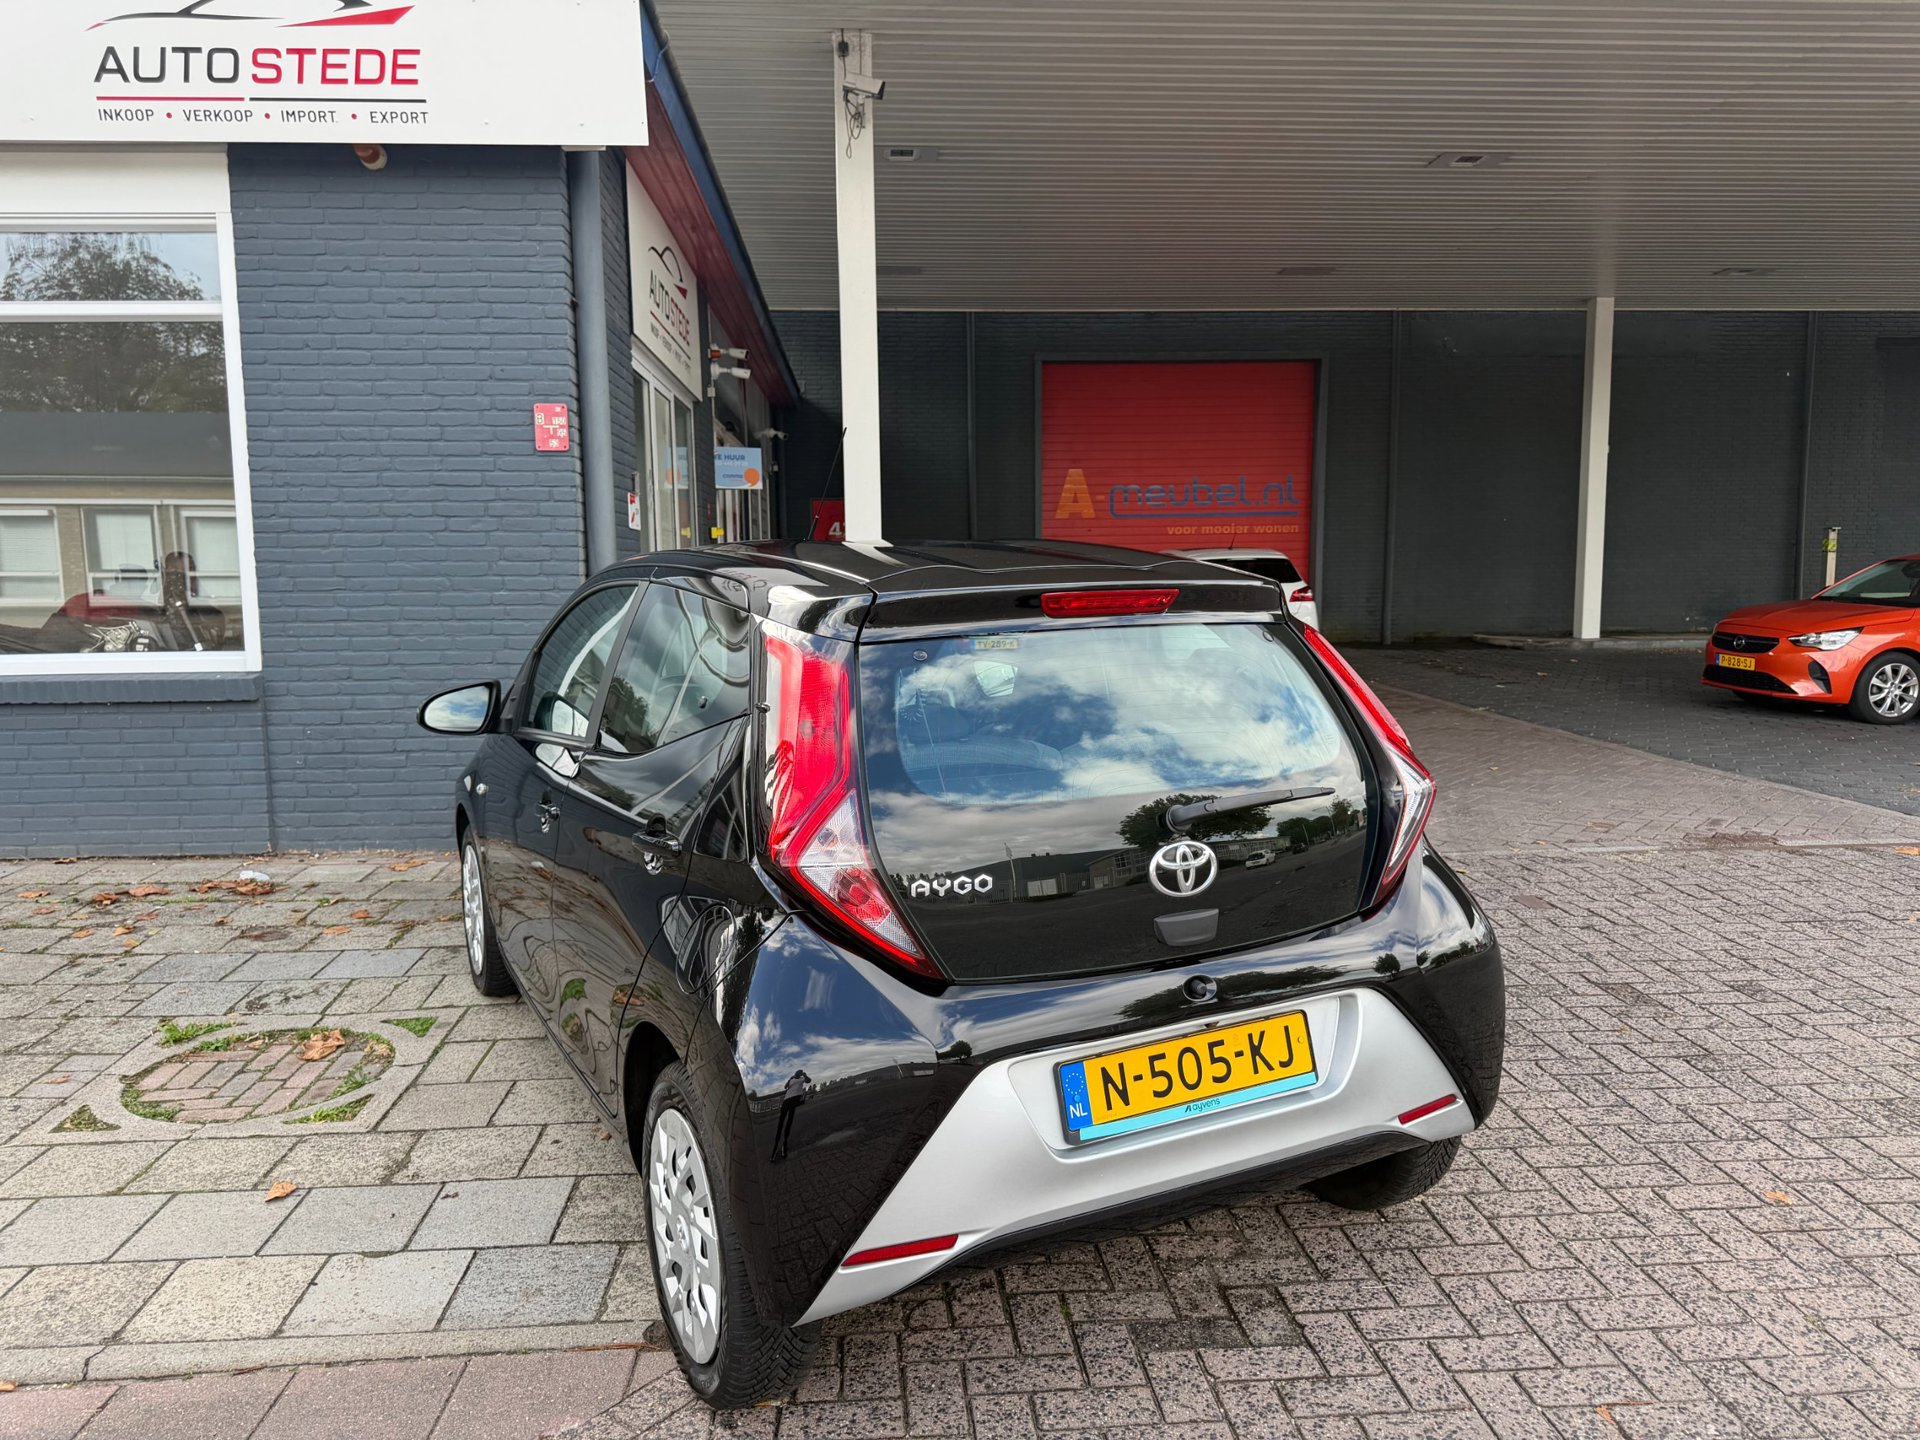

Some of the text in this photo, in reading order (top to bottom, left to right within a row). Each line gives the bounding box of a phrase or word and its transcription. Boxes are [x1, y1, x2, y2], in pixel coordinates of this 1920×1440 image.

[98, 108, 429, 124] INKOOP VERKOOP IMPORT EXPORT
[1167, 523, 1299, 535] voor mooier wonen
[1721, 656, 1752, 669] P-828-SJ
[910, 873, 993, 898] AYGO
[1100, 1025, 1294, 1111] N-505-KJ
[1069, 1101, 1088, 1119] NL
